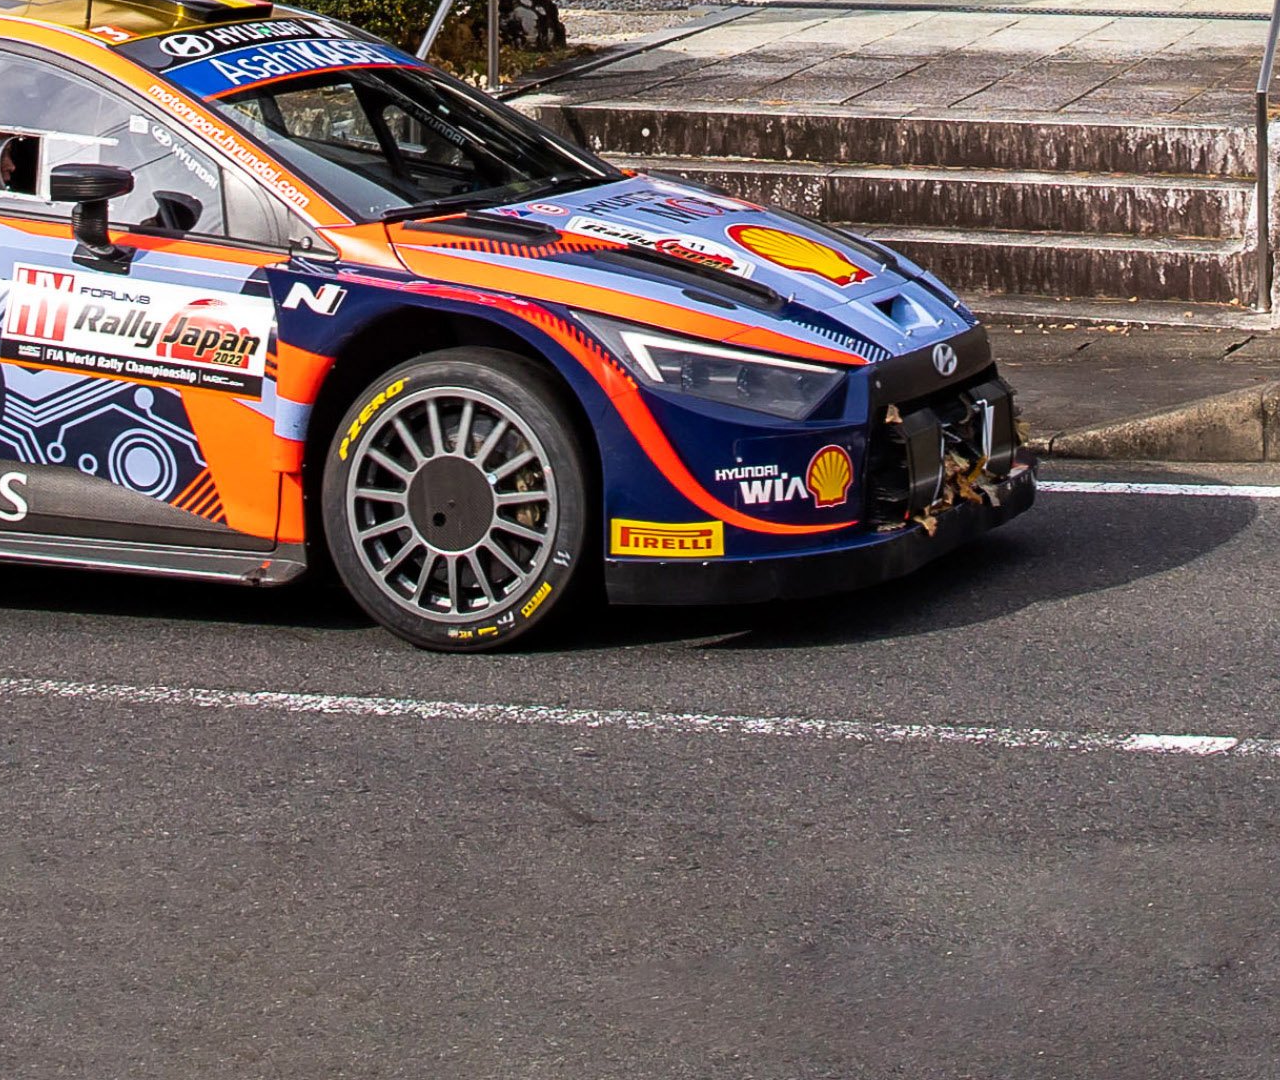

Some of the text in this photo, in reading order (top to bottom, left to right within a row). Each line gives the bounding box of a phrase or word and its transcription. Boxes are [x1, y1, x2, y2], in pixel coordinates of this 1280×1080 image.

[205, 18, 313, 46] HYUNDAI
[147, 83, 310, 209] motorsport.hyundai.com
[171, 143, 218, 190] HYUNDAI
[689, 241, 705, 251] 11
[73, 302, 260, 358] Rally Japan
[46, 348, 64, 362] FIA
[66, 351, 96, 366] World
[97, 356, 123, 372] Rally
[125, 360, 197, 383] Championship
[212, 351, 244, 367] 2022
[715, 464, 778, 481] HYUNDAI
[739, 472, 809, 504] WIA
[620, 526, 713, 550] PIRELLI
